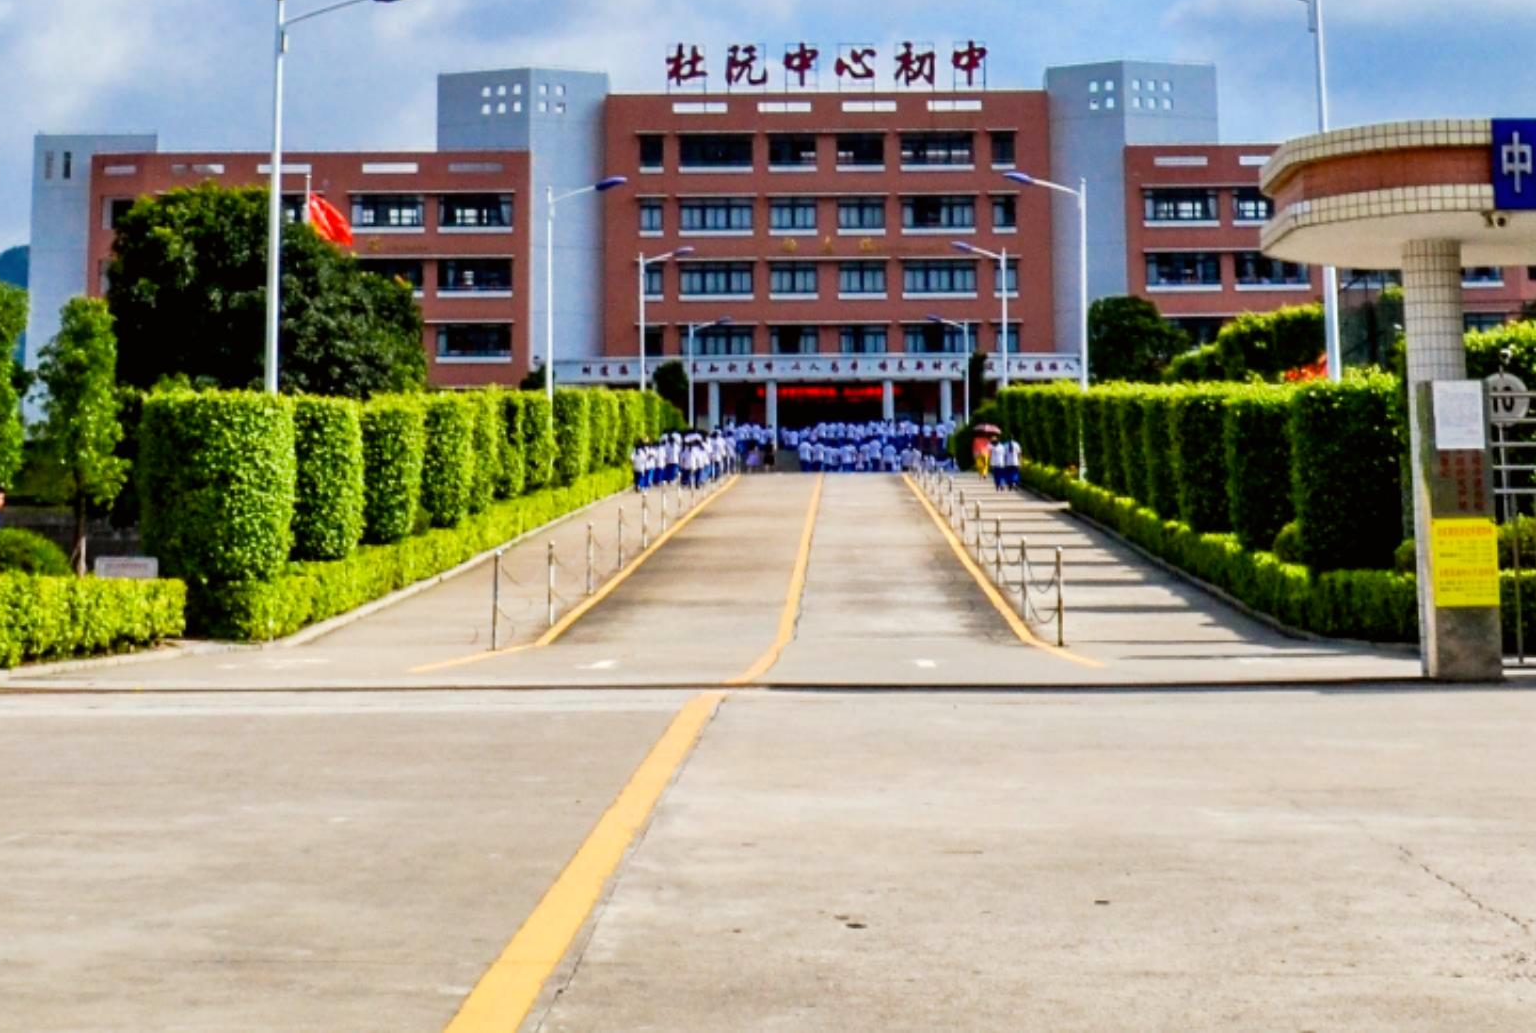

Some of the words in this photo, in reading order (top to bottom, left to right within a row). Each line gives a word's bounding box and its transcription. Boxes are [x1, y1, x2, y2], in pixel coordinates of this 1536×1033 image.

[666, 41, 986, 85] 杜阮中心初中
